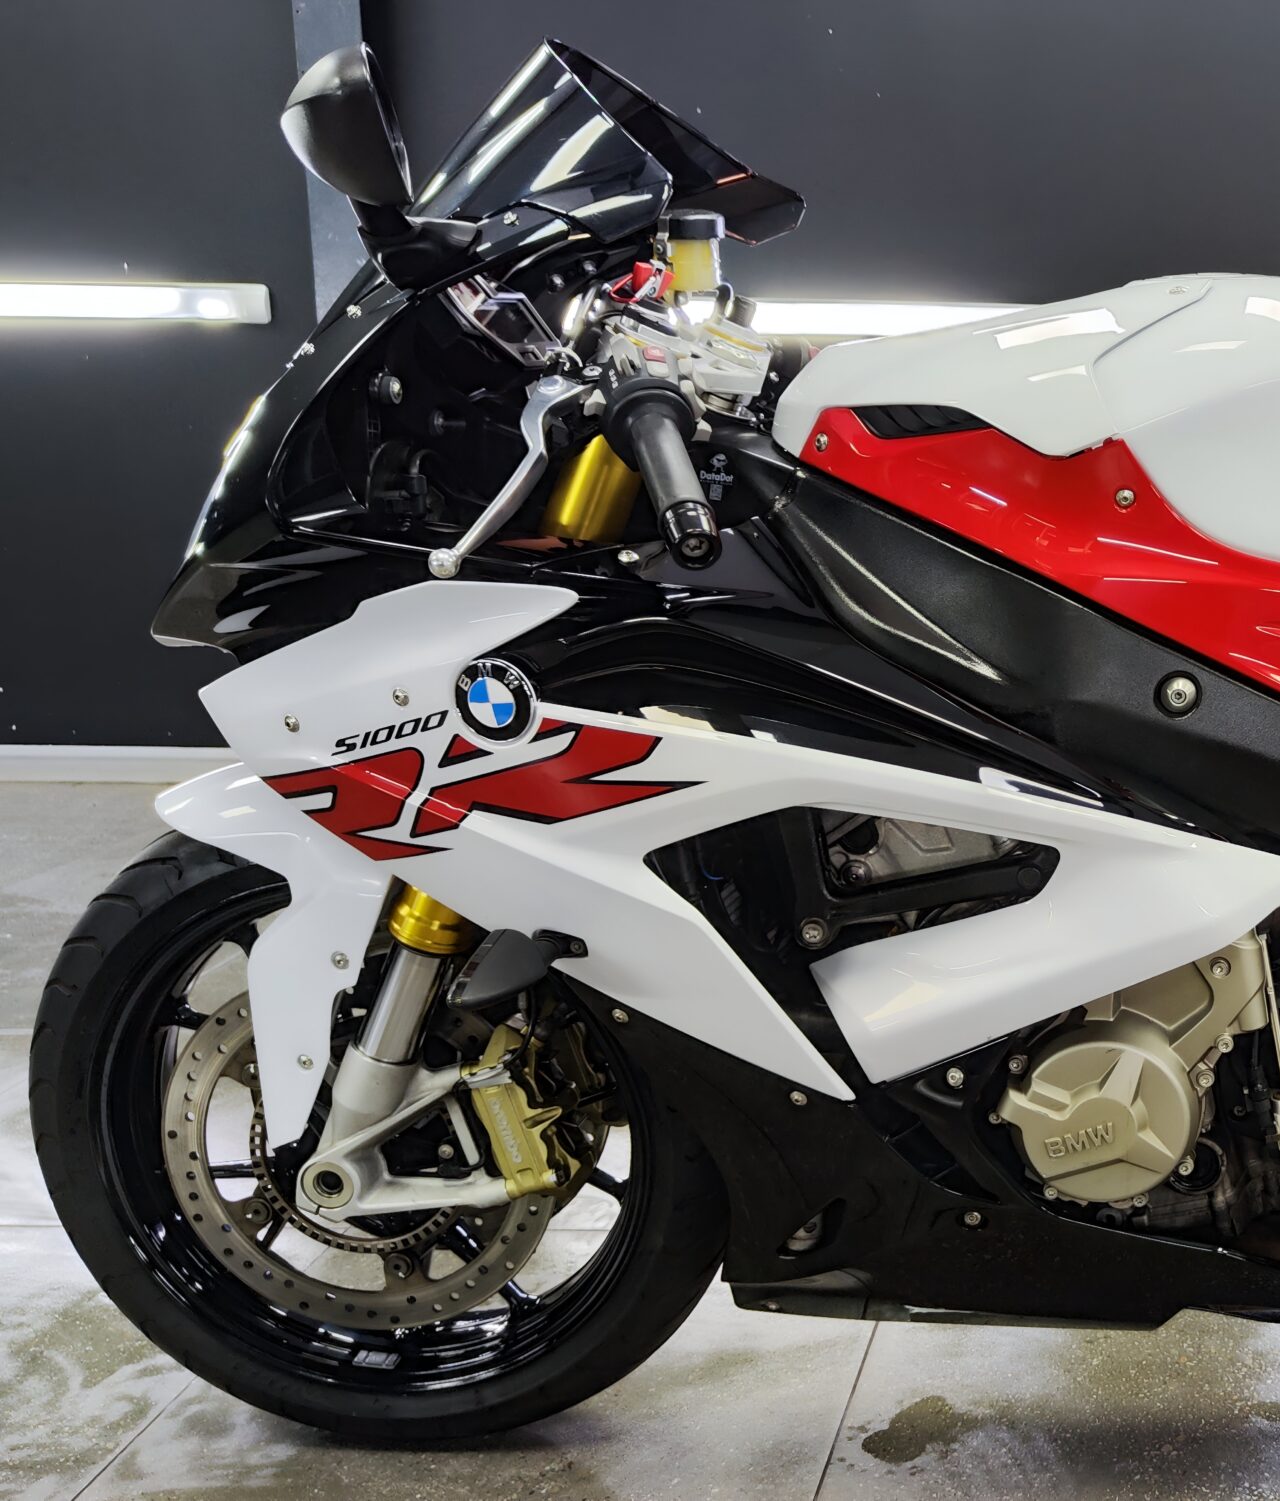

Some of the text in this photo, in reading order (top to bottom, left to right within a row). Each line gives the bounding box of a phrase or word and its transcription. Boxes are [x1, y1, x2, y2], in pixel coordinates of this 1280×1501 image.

[699, 470, 734, 483] DataDot
[457, 661, 521, 692] BMW
[332, 709, 450, 756] S1000
[1043, 1121, 1115, 1159] BMW
